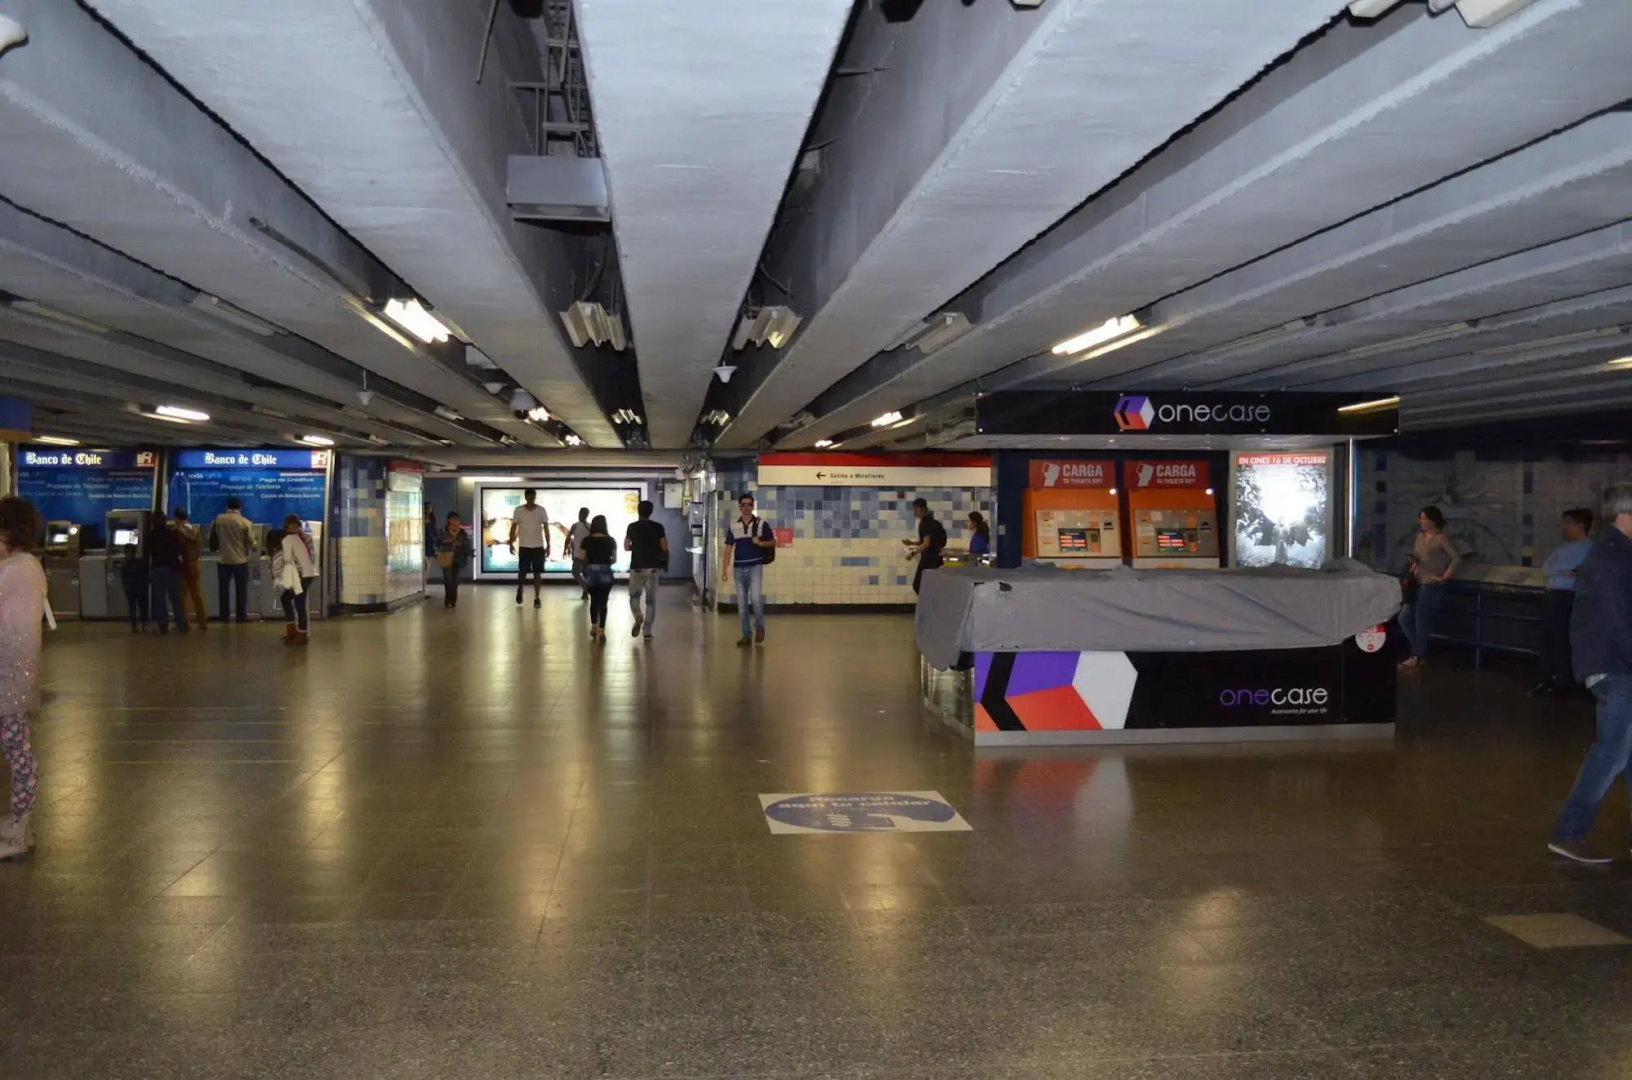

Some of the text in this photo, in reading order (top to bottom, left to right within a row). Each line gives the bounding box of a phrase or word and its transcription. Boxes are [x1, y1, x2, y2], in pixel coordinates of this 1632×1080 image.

[1158, 404, 1270, 422] onecase
[25, 452, 102, 466] Banco de Chile
[204, 452, 277, 466] Banco de Chile
[1283, 456, 1292, 464] DE
[1293, 456, 1326, 464] OCTUBRE
[1062, 464, 1103, 477] CARGA
[1156, 464, 1196, 477] CARGA
[1220, 688, 1328, 705] onecase
